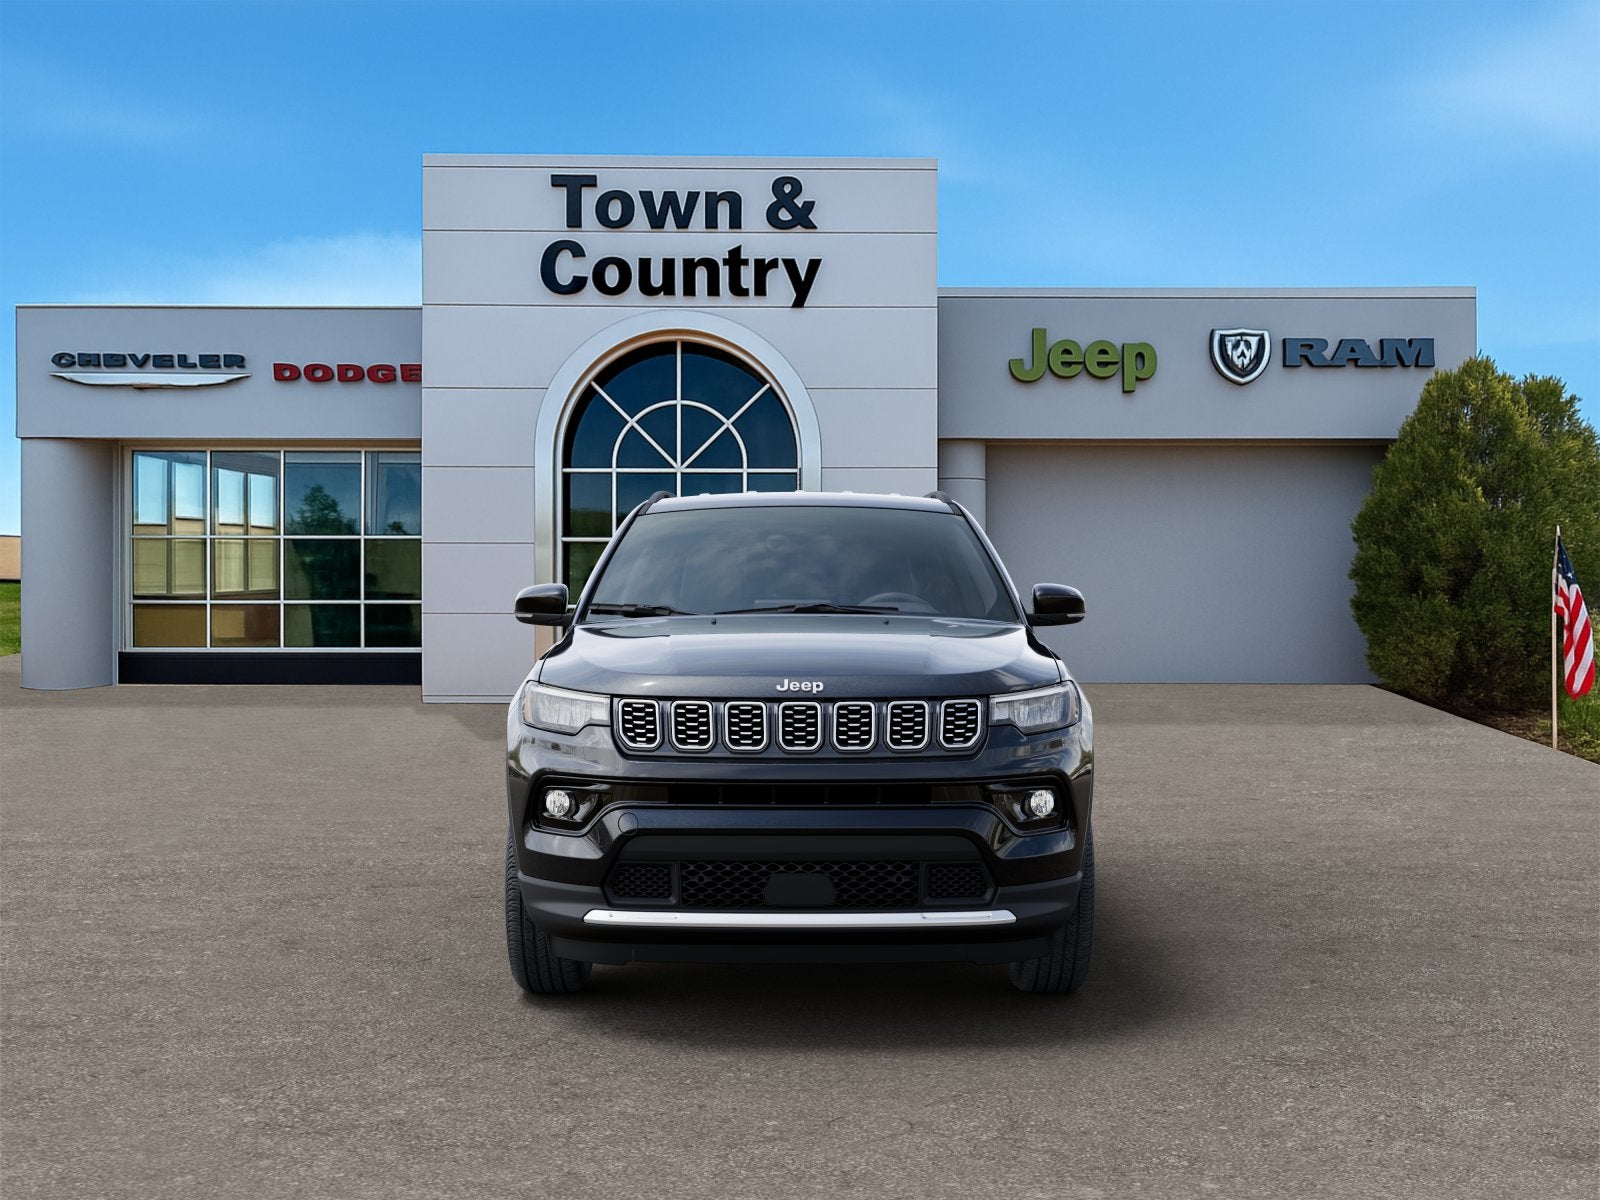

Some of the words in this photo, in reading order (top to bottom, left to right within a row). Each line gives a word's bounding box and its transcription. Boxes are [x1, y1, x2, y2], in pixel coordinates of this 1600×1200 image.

[550, 174, 742, 229] Town
[765, 176, 818, 230] &
[540, 239, 822, 308] Country
[273, 363, 422, 383] DODGE
[1008, 328, 1157, 393] Jeep
[1282, 338, 1436, 368] RAM
[776, 678, 824, 694] Jeep
